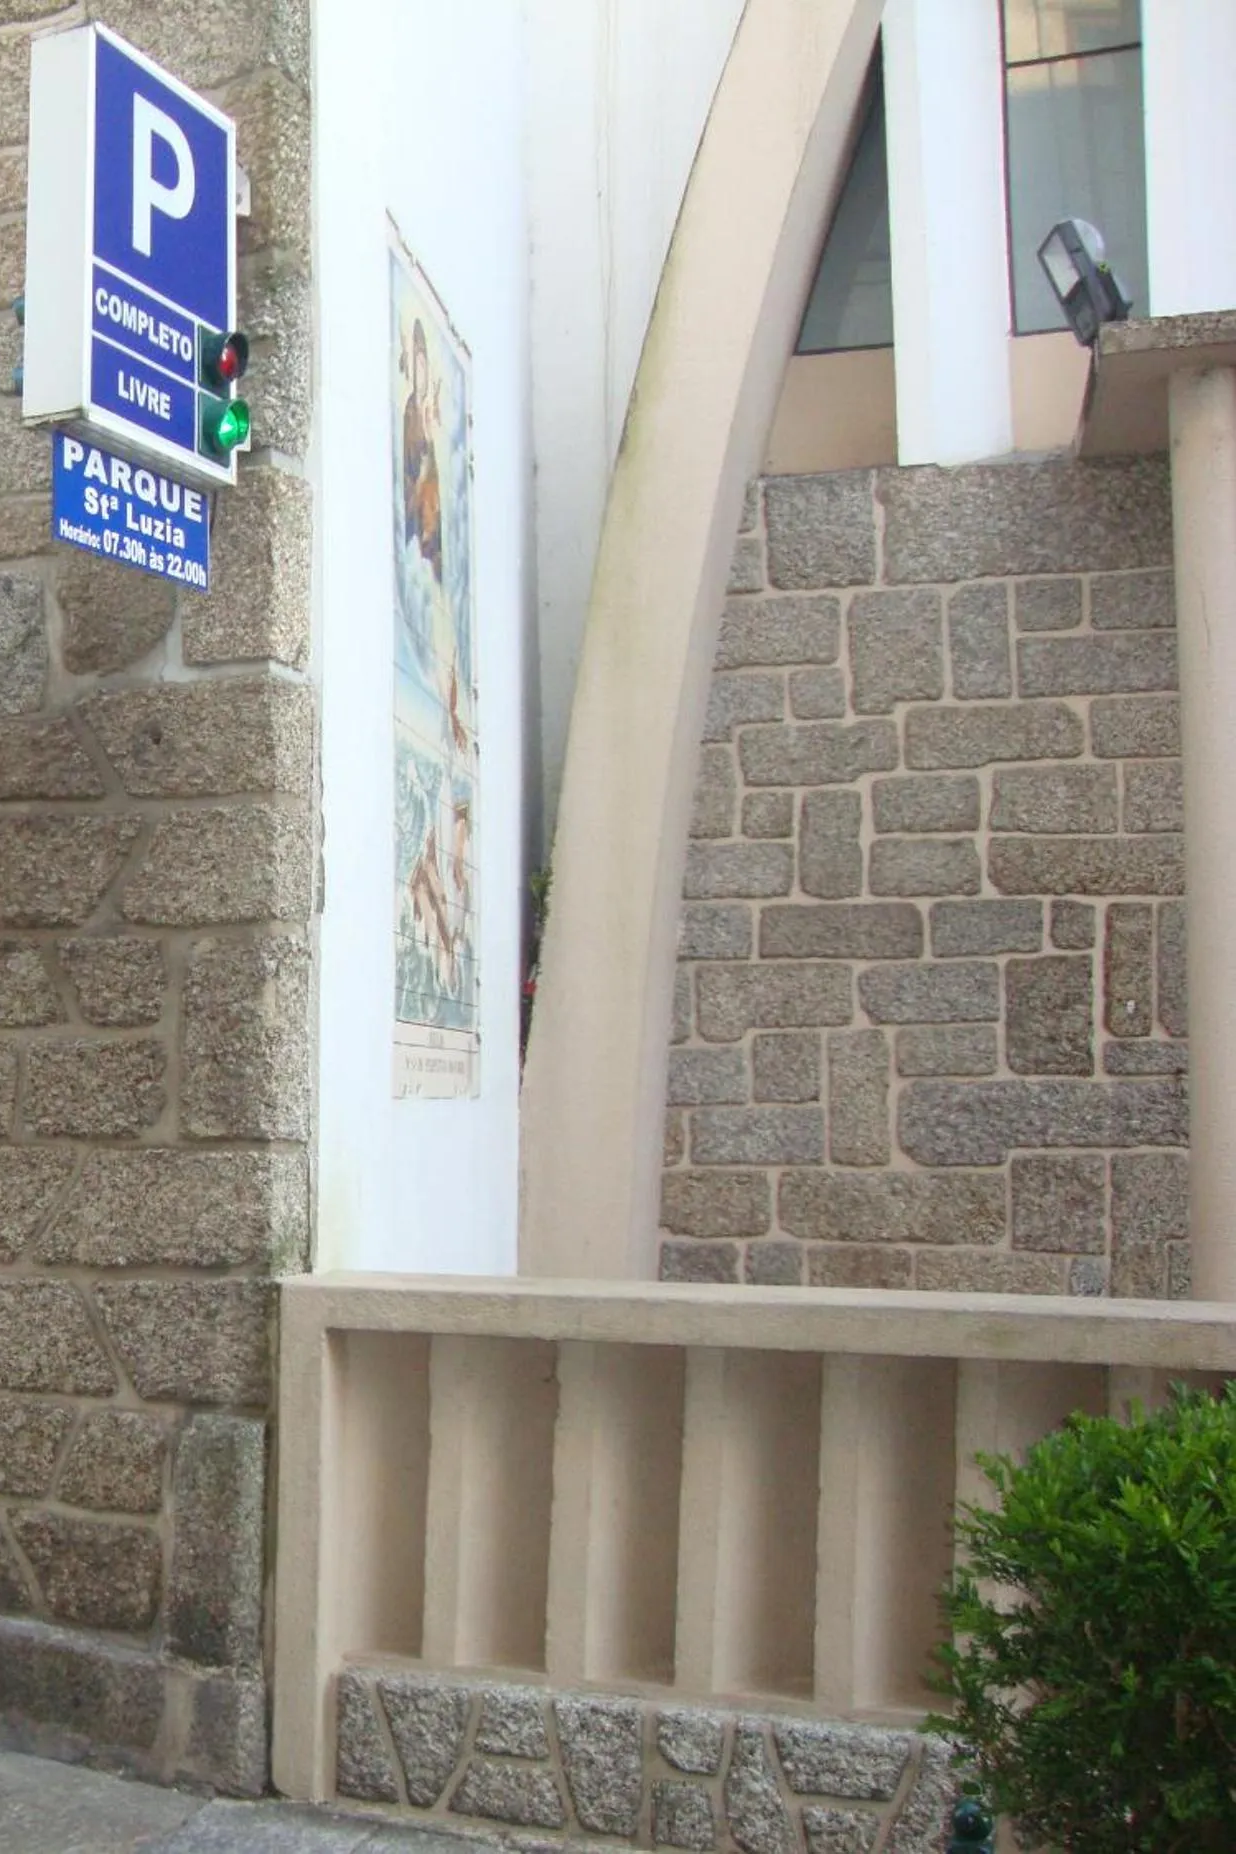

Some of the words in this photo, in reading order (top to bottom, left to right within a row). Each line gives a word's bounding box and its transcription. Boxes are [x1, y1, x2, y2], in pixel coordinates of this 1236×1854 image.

[132, 91, 196, 258] P
[94, 287, 193, 363] COMPLETO
[117, 370, 171, 421] LIVRE
[63, 436, 203, 524] PARQUE
[103, 528, 147, 567] 07.30h
[166, 552, 207, 588] 22.00h
[126, 502, 185, 550] Luzia
